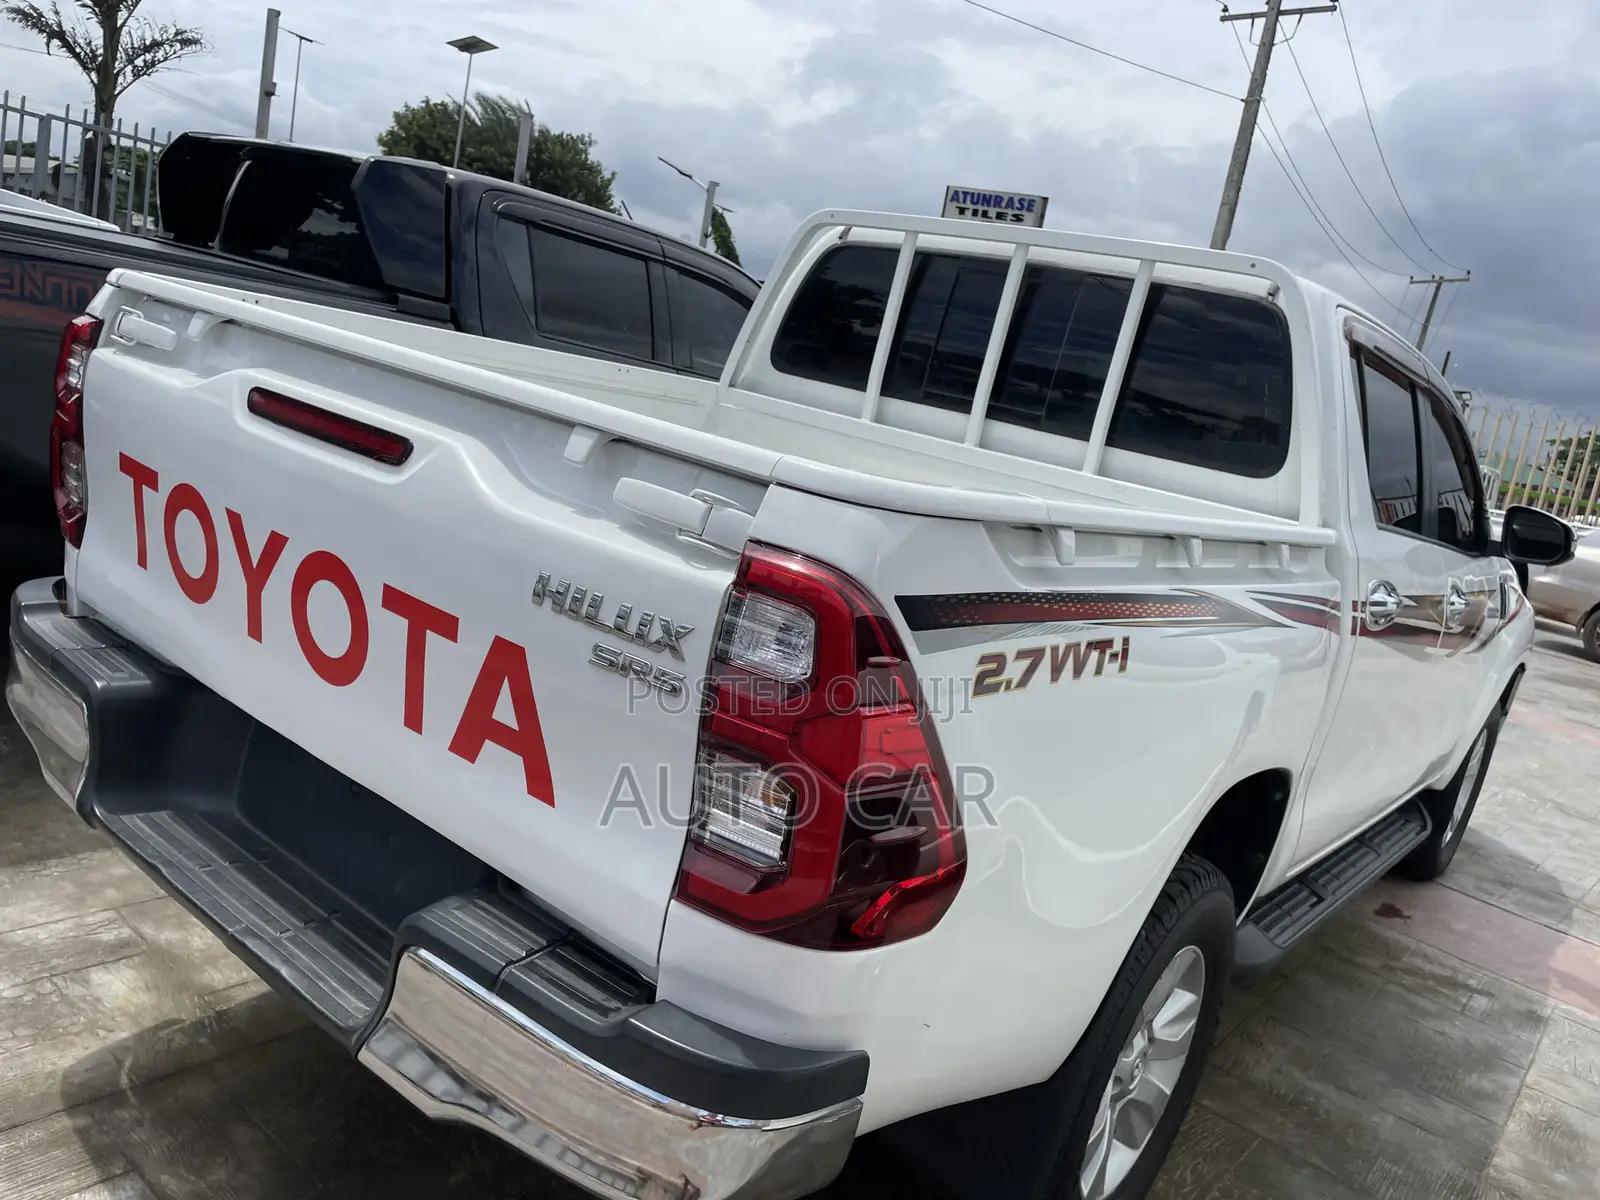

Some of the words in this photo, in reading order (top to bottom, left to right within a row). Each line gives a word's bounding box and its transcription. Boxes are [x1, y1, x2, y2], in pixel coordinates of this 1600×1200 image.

[950, 190, 1037, 213] ATUNRASE
[955, 206, 1025, 223] TILES
[118, 451, 556, 810] TOYOTA
[532, 570, 696, 662] HILUX
[588, 642, 686, 698] SR5
